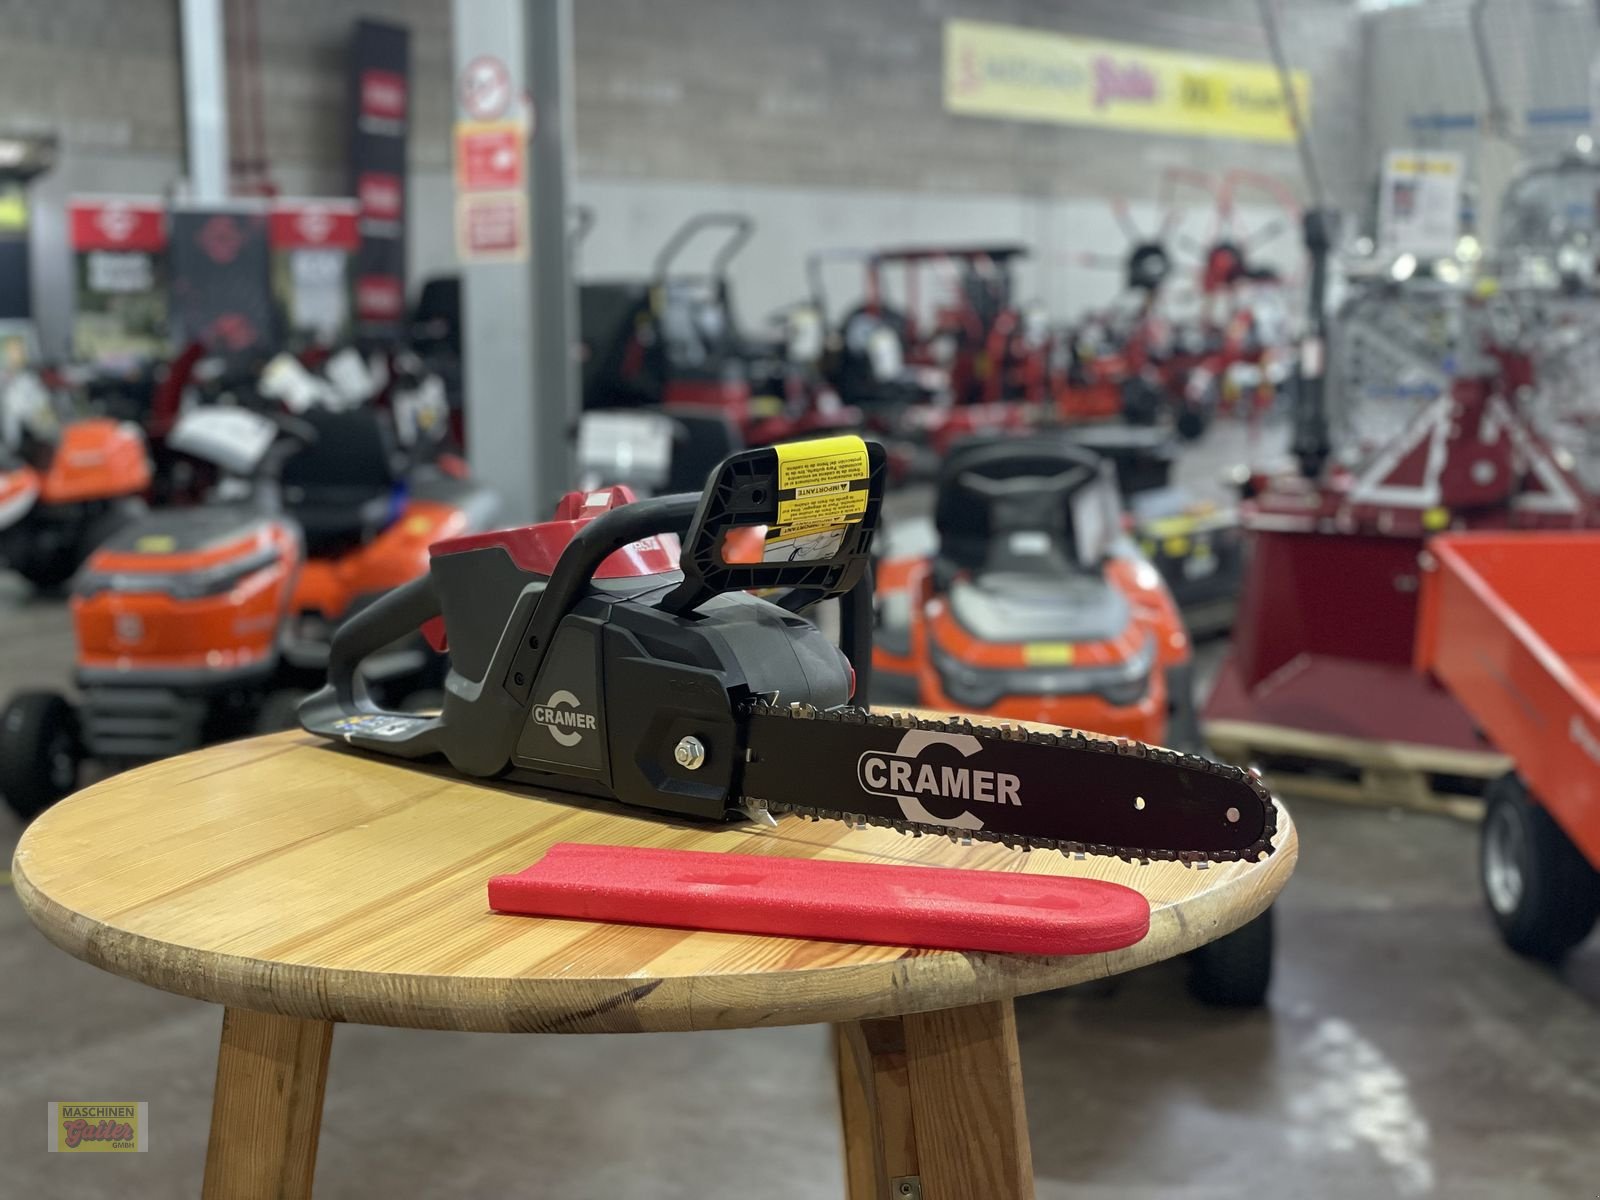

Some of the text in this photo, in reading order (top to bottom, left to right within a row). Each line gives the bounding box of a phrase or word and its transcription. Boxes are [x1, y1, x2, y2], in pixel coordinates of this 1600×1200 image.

[798, 483, 840, 497] IMPORTANTE
[535, 707, 596, 730] CRAMER
[864, 757, 1022, 806] CRAMER
